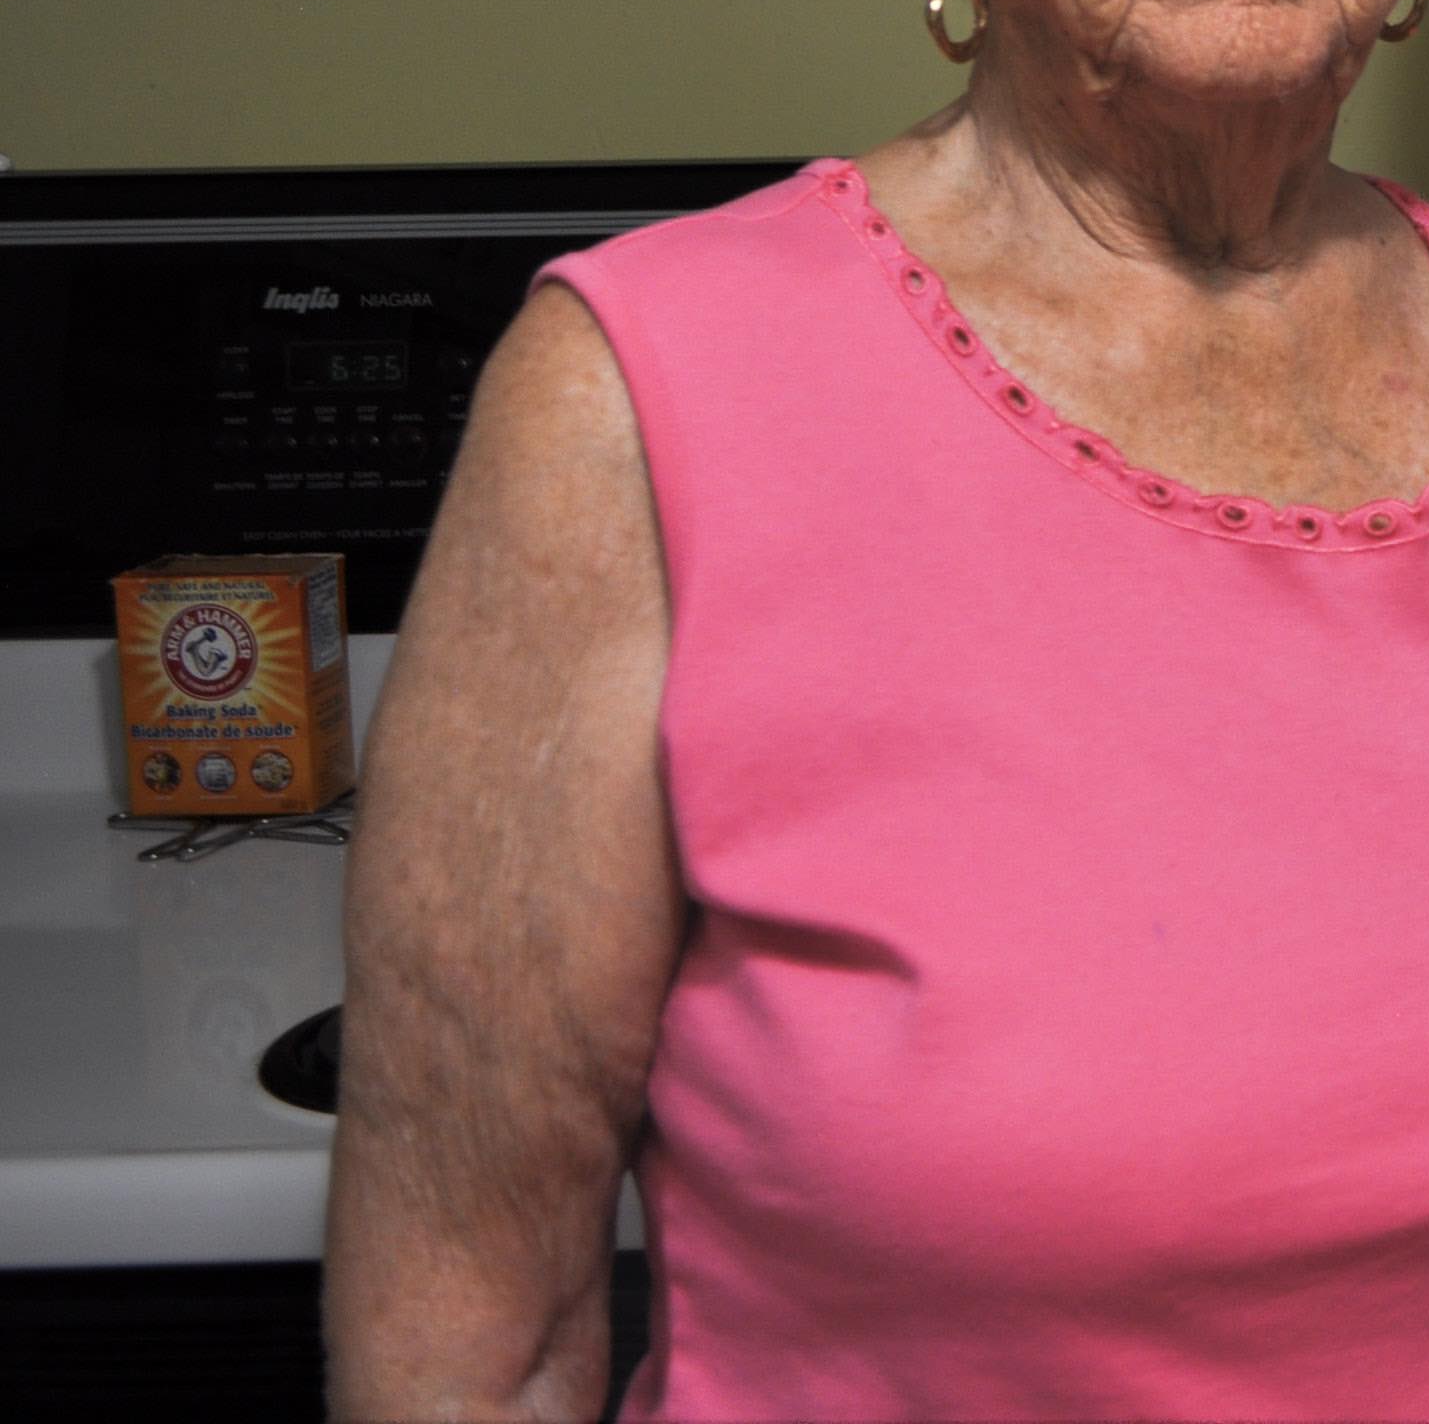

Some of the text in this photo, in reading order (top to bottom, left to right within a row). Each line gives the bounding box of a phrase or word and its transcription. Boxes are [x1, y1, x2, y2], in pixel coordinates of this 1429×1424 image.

[264, 287, 433, 314] Inglis NIAGARA
[167, 622, 187, 662] ARM
[197, 610, 250, 659] HAMMER
[166, 704, 257, 720] Baking Soda
[131, 724, 293, 738] Bicarbonate de soude
